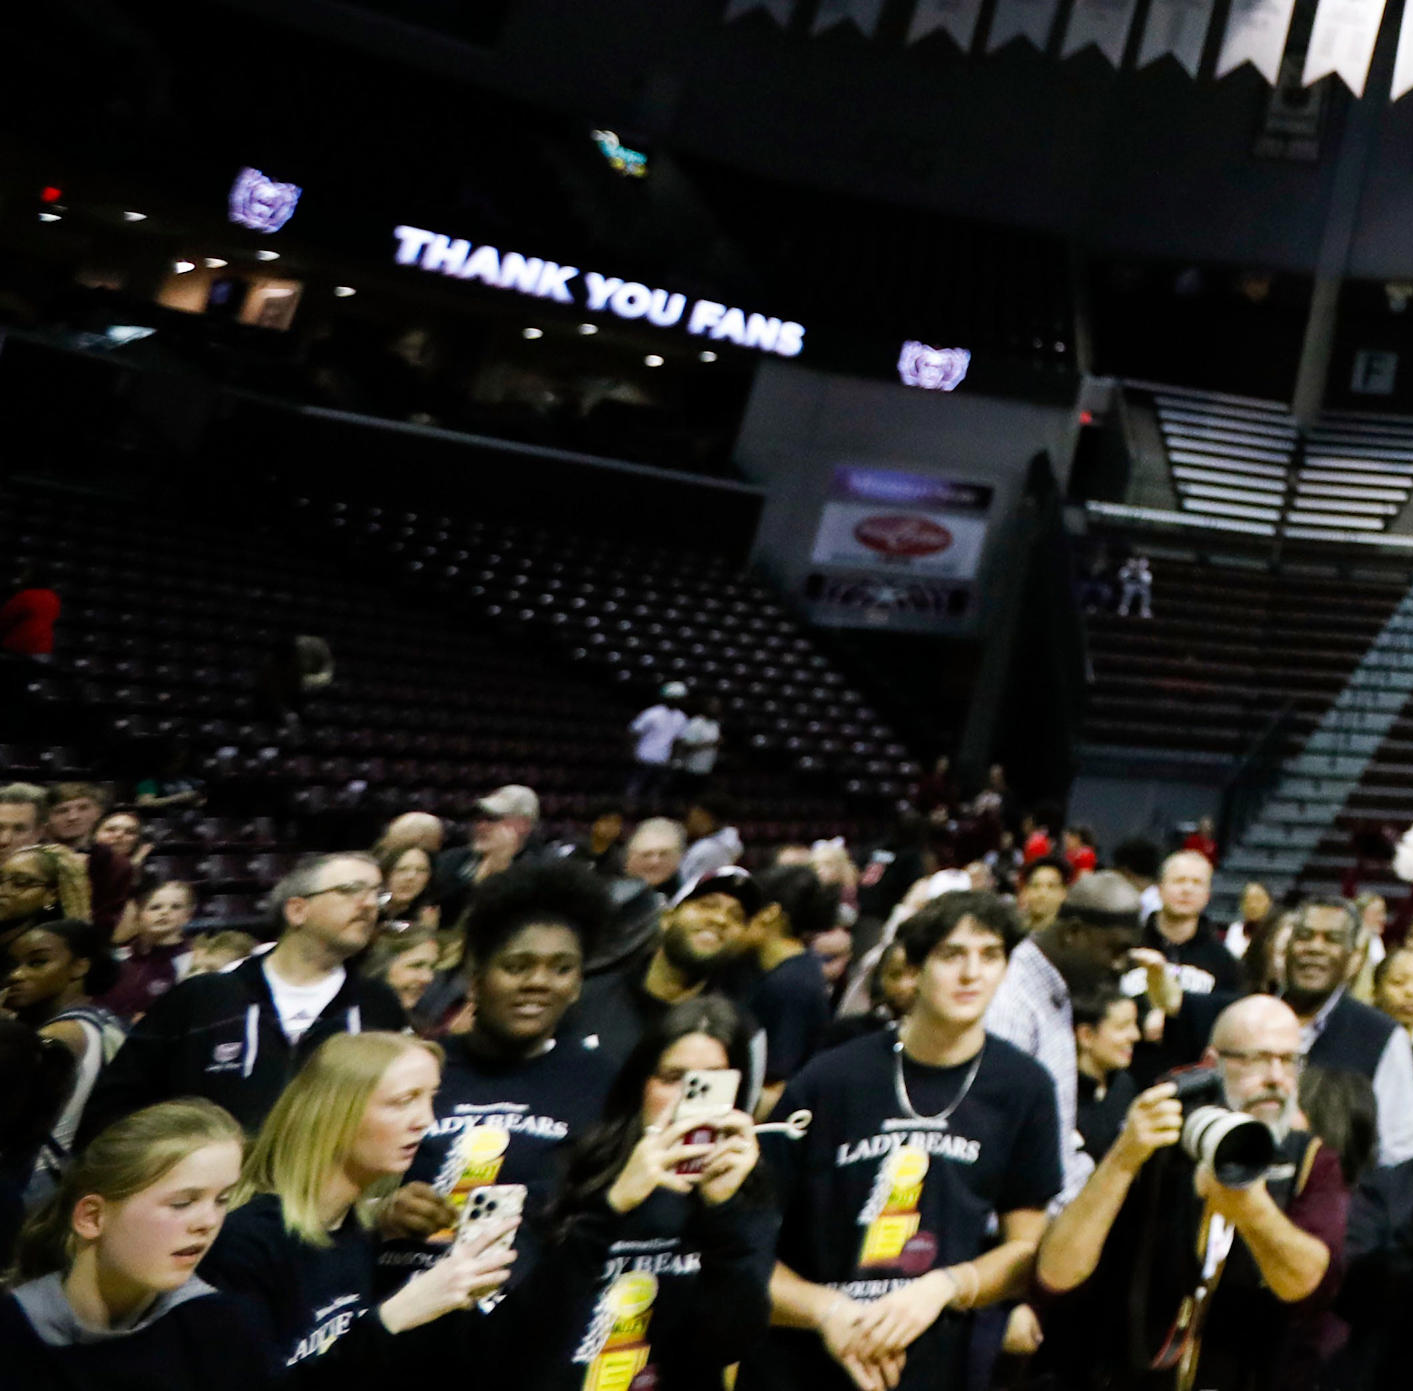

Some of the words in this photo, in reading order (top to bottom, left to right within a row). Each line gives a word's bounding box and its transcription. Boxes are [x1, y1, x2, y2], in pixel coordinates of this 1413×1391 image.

[394, 224, 579, 304] THANK
[585, 271, 687, 327] YOU
[686, 299, 805, 357] FANS
[424, 1114, 483, 1138] ADY
[484, 1113, 569, 1140] BEARS
[836, 1131, 908, 1168] LADY
[908, 1131, 981, 1164] BEARS
